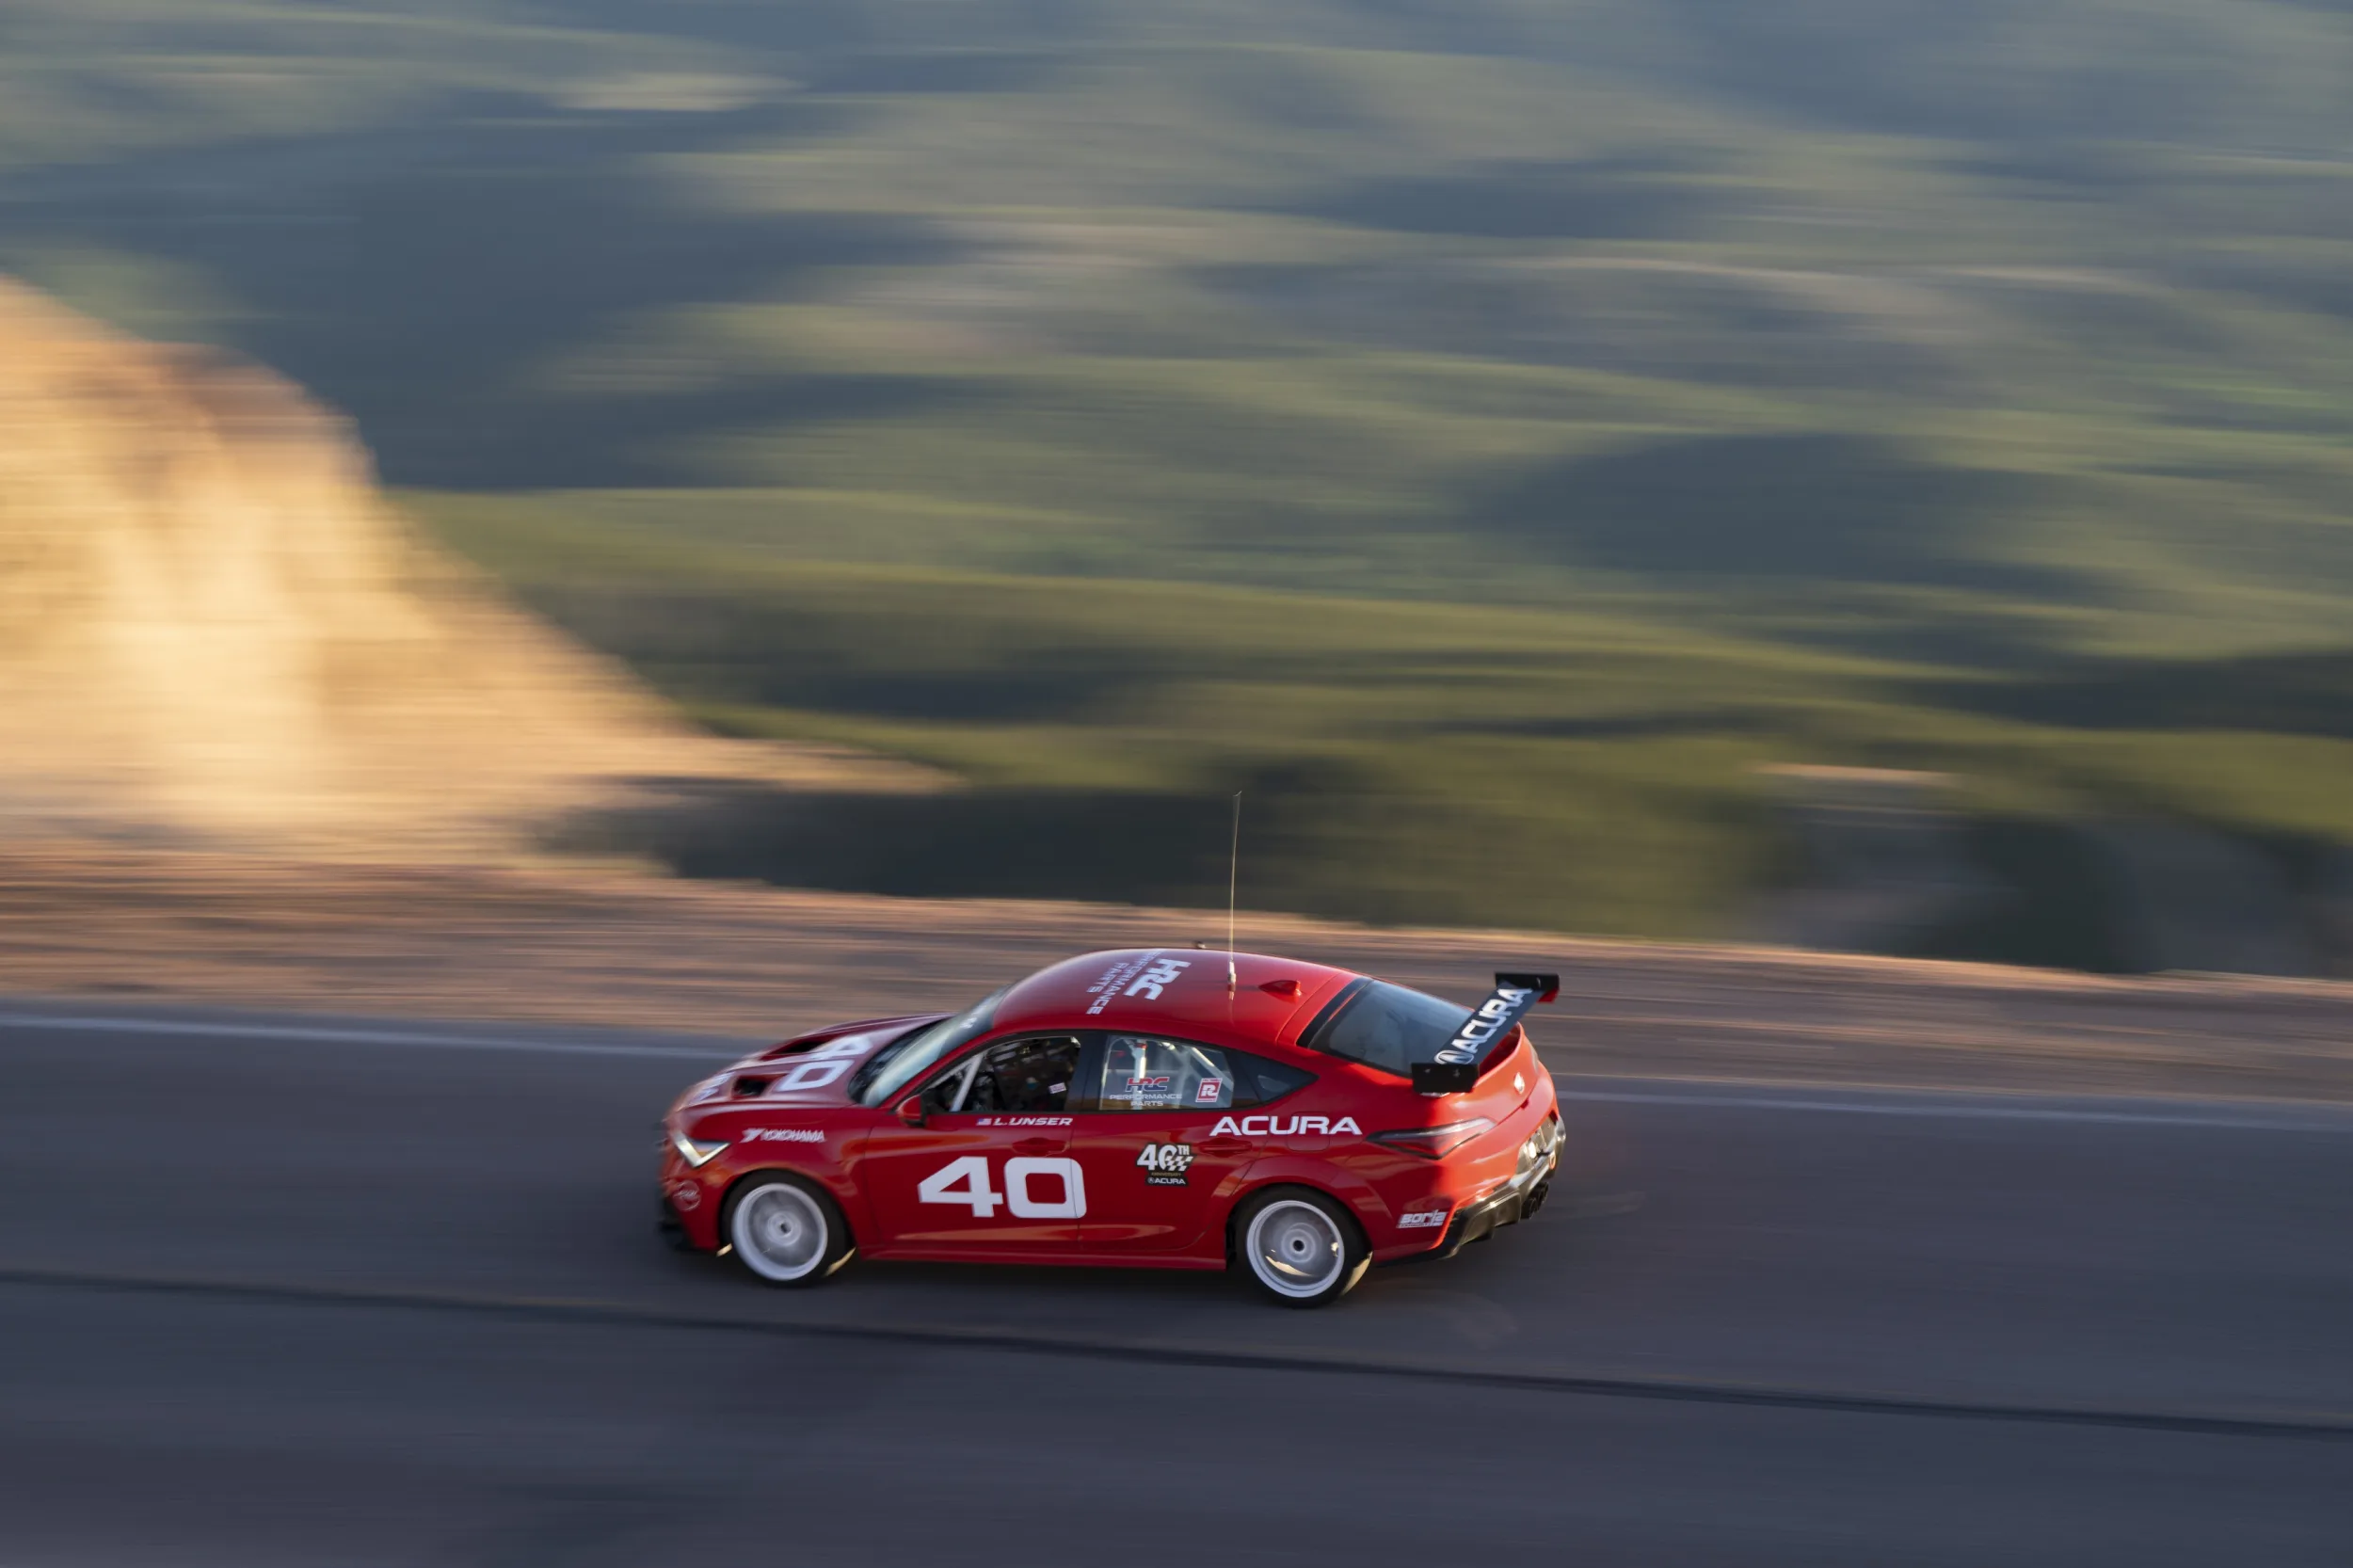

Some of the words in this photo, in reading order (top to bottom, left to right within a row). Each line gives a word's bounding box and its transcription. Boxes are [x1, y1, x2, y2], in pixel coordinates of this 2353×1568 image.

[1123, 958, 1192, 1000] HRC
[1451, 988, 1533, 1054] ACURA
[1125, 1076, 1170, 1093] HRC
[760, 1128, 826, 1144] YOKOHAMA
[1209, 1115, 1363, 1137] ACURA
[917, 1155, 1087, 1220] 40
